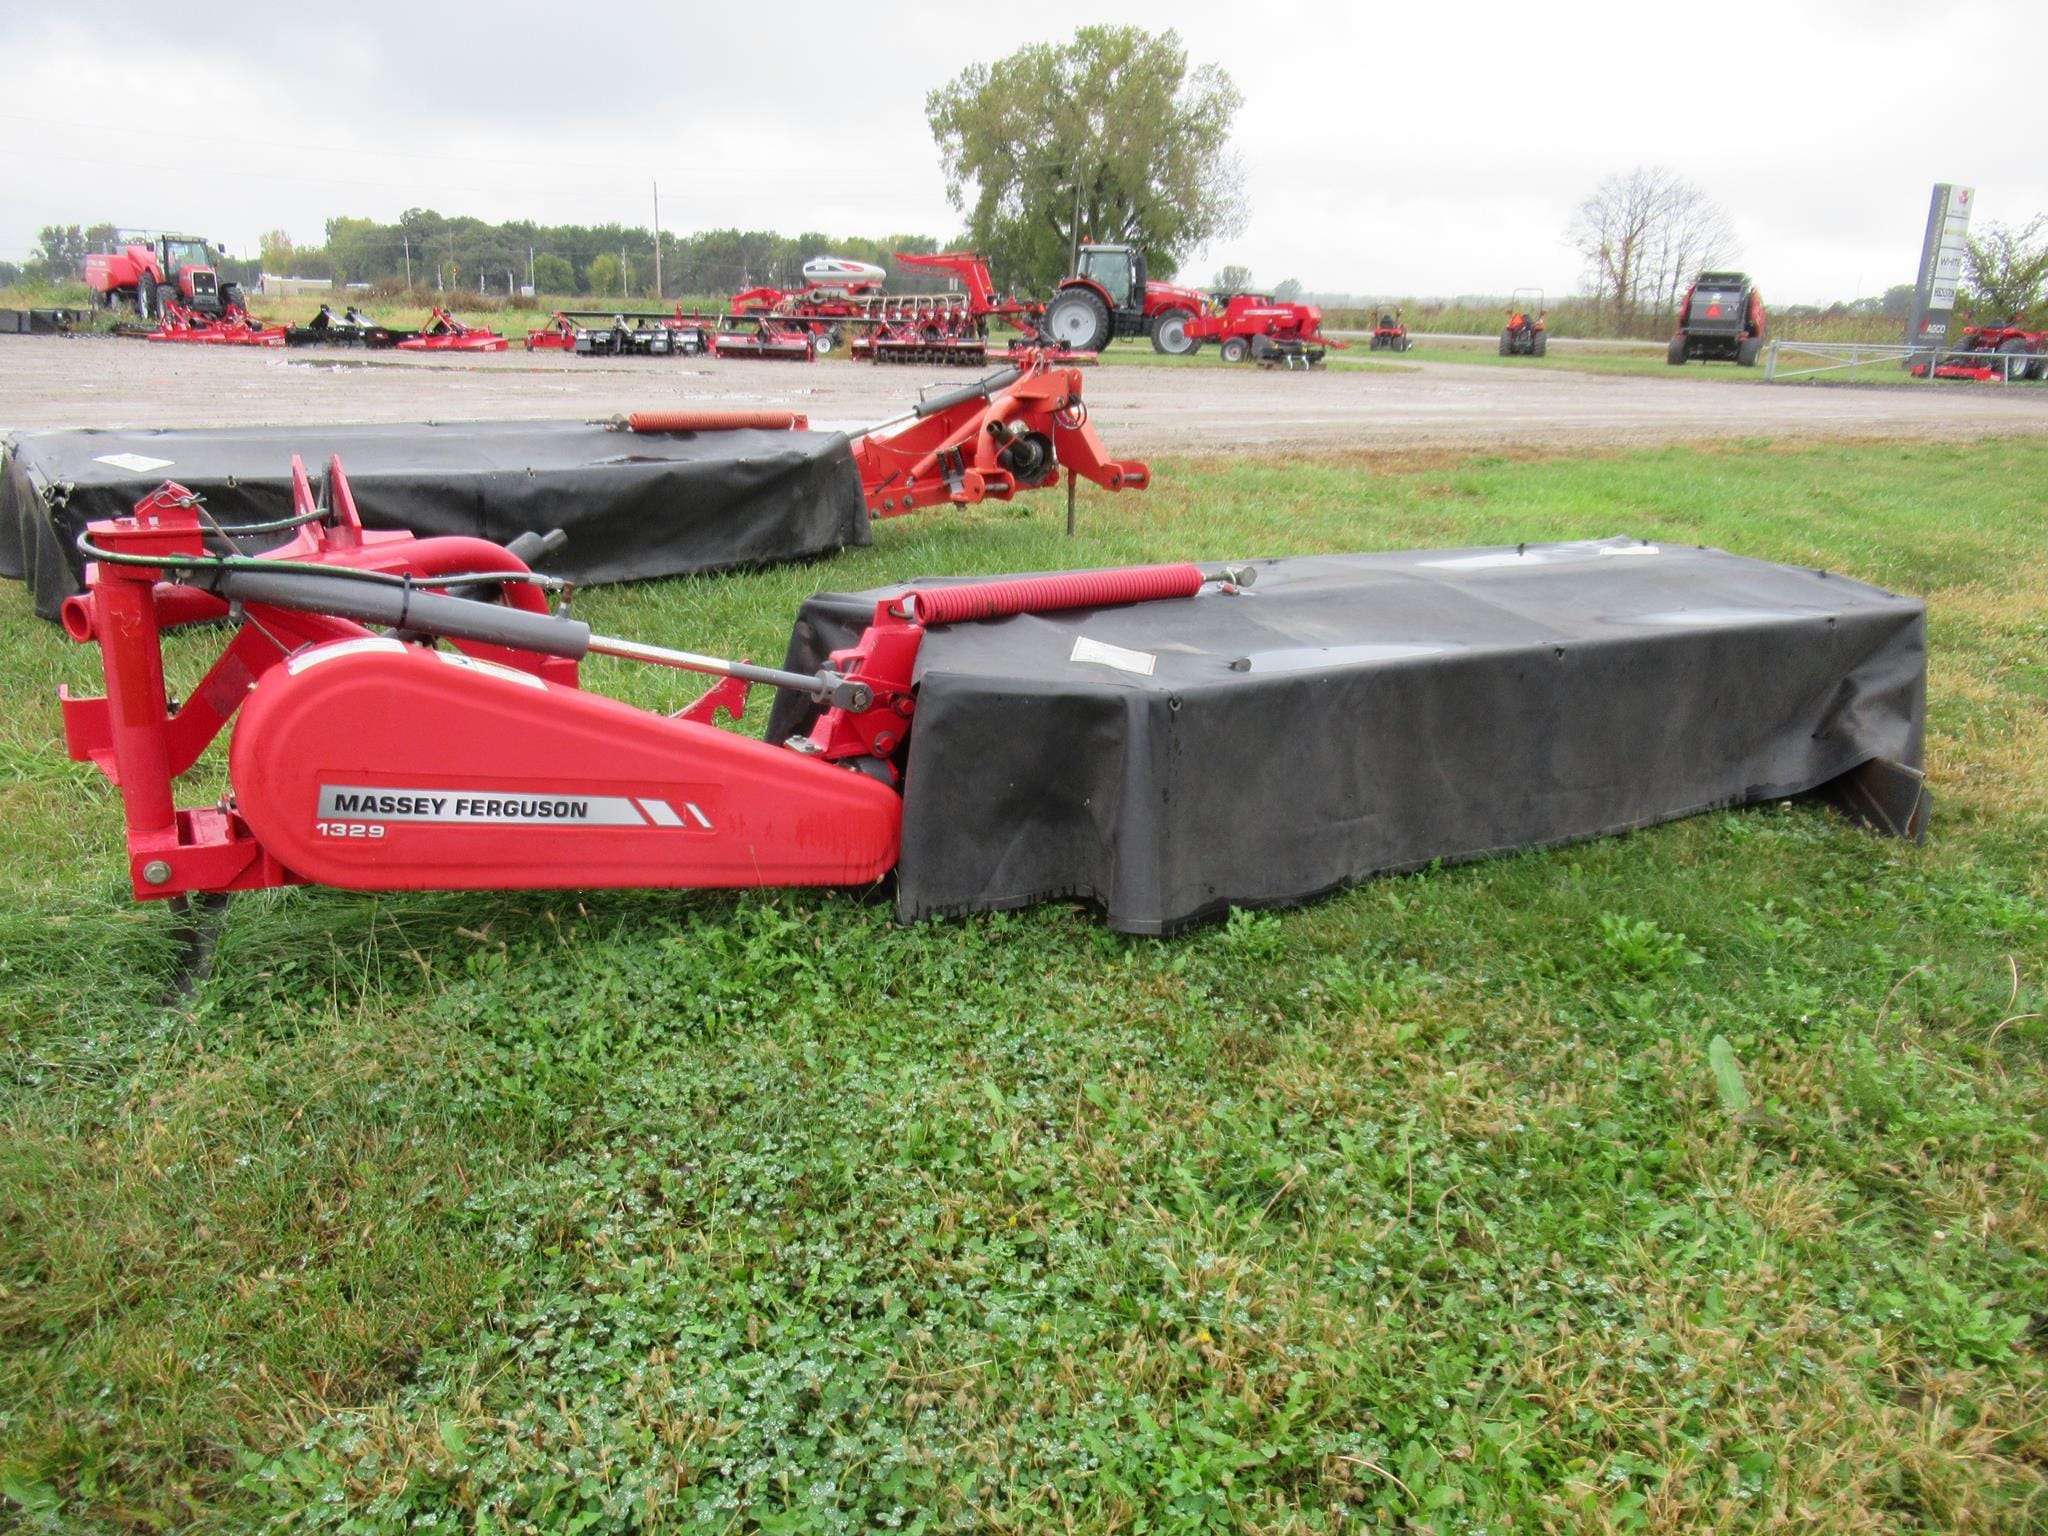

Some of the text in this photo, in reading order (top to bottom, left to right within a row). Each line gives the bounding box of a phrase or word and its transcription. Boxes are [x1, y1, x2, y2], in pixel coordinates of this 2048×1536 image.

[334, 794, 588, 818] MASSEY FERGUSON
[315, 822, 386, 839] 1329
